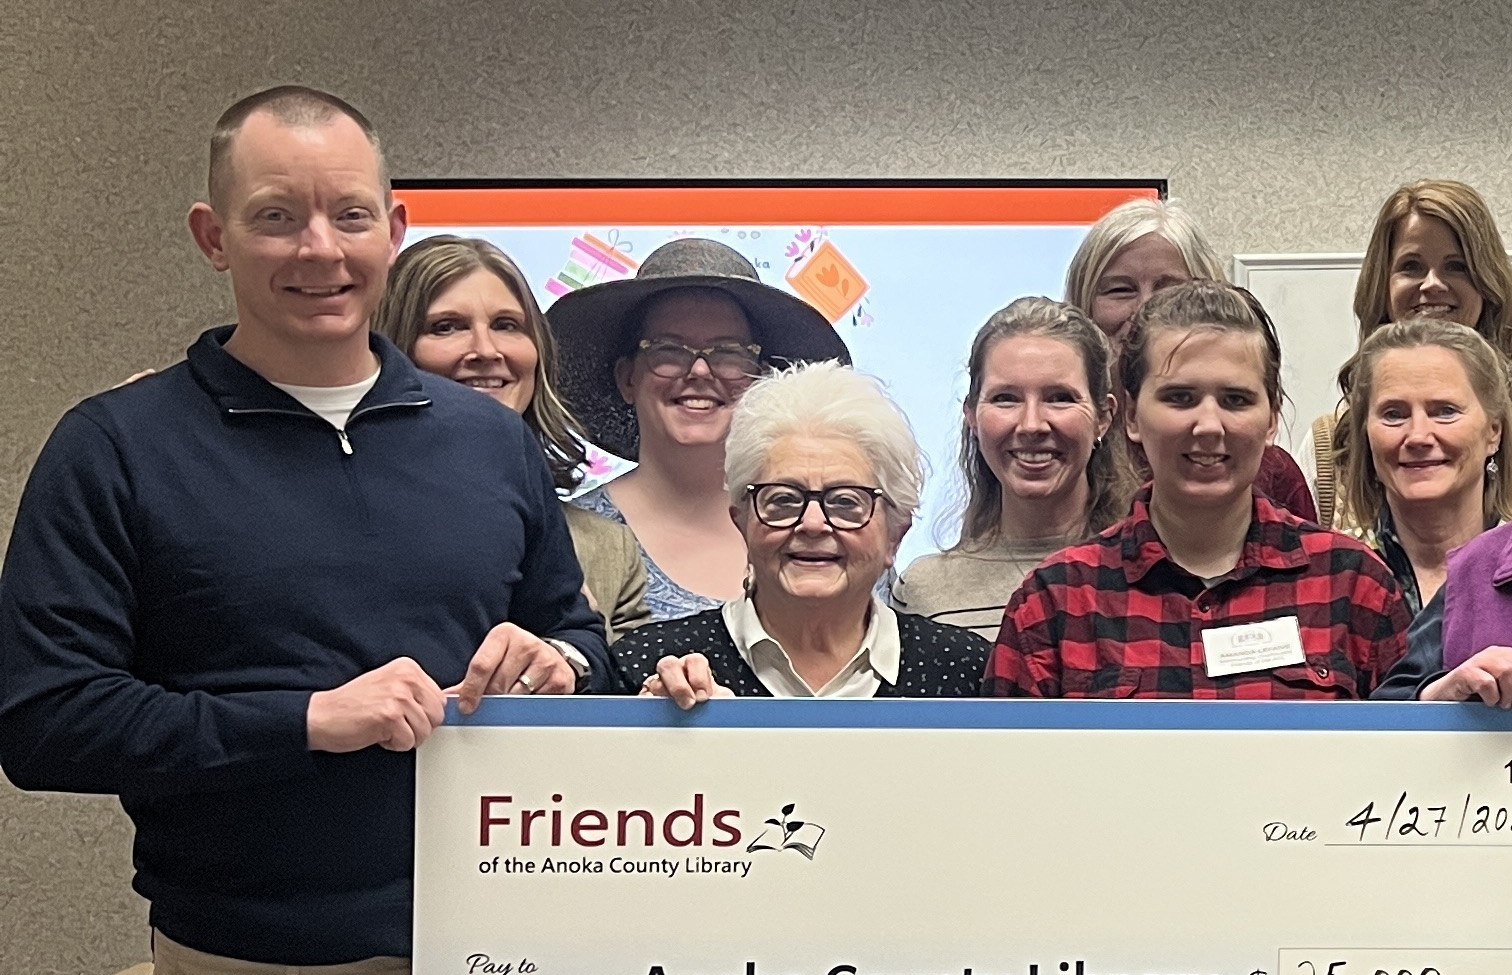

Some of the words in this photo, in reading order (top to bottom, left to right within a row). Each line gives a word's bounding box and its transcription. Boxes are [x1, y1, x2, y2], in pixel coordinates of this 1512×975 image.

[480, 794, 742, 848] Friends
[1262, 822, 1317, 842] Date
[479, 856, 499, 873] of
[504, 857, 535, 873] the
[541, 857, 604, 873] Anoka
[609, 857, 679, 878] County
[685, 857, 752, 878] Library
[517, 958, 539, 974] to
